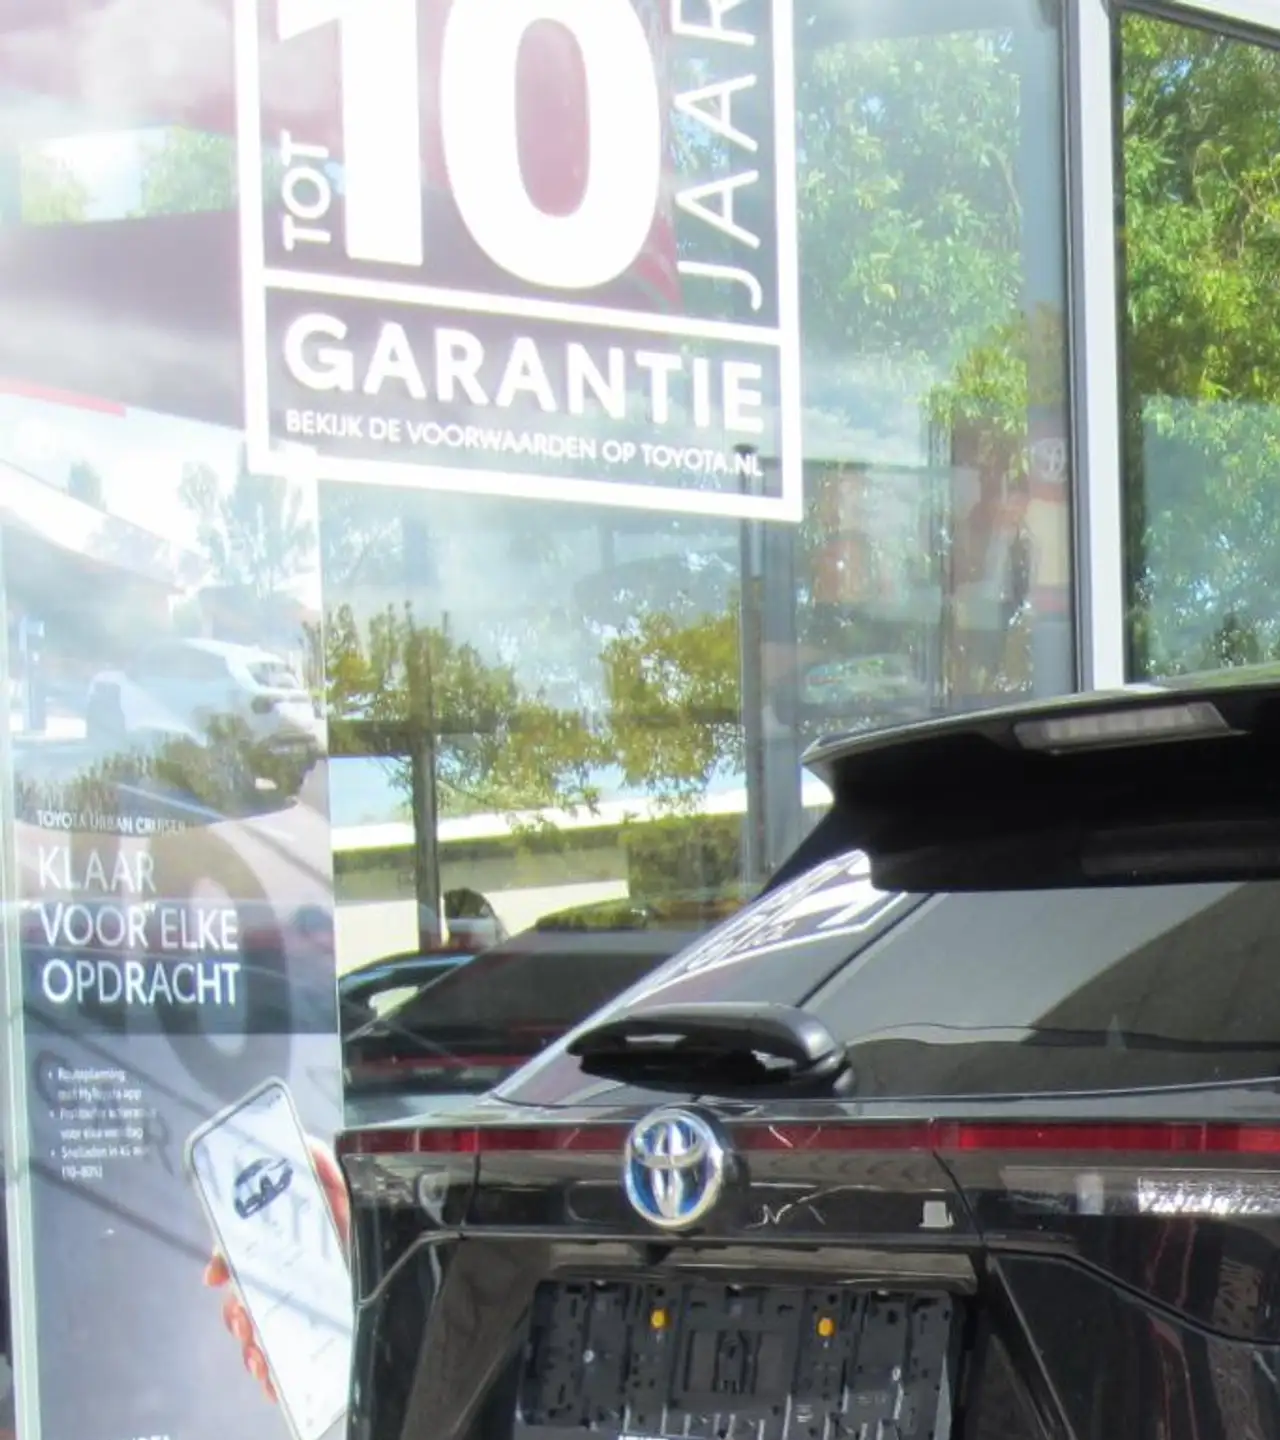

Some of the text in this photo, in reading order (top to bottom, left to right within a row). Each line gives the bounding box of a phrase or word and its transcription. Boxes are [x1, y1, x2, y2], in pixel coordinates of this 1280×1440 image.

[277, 0, 661, 289] 10
[280, 130, 331, 252] TOT
[283, 313, 765, 434] GARANTIE
[285, 409, 766, 478] BEKIJK DE VOORWAARDEN OP TOYOTA.NL
[37, 809, 87, 830] TOYOTA
[38, 846, 157, 894] KLAAR
[39, 902, 240, 951] VOOR ELKE
[42, 957, 241, 1006] OPDRACHT
